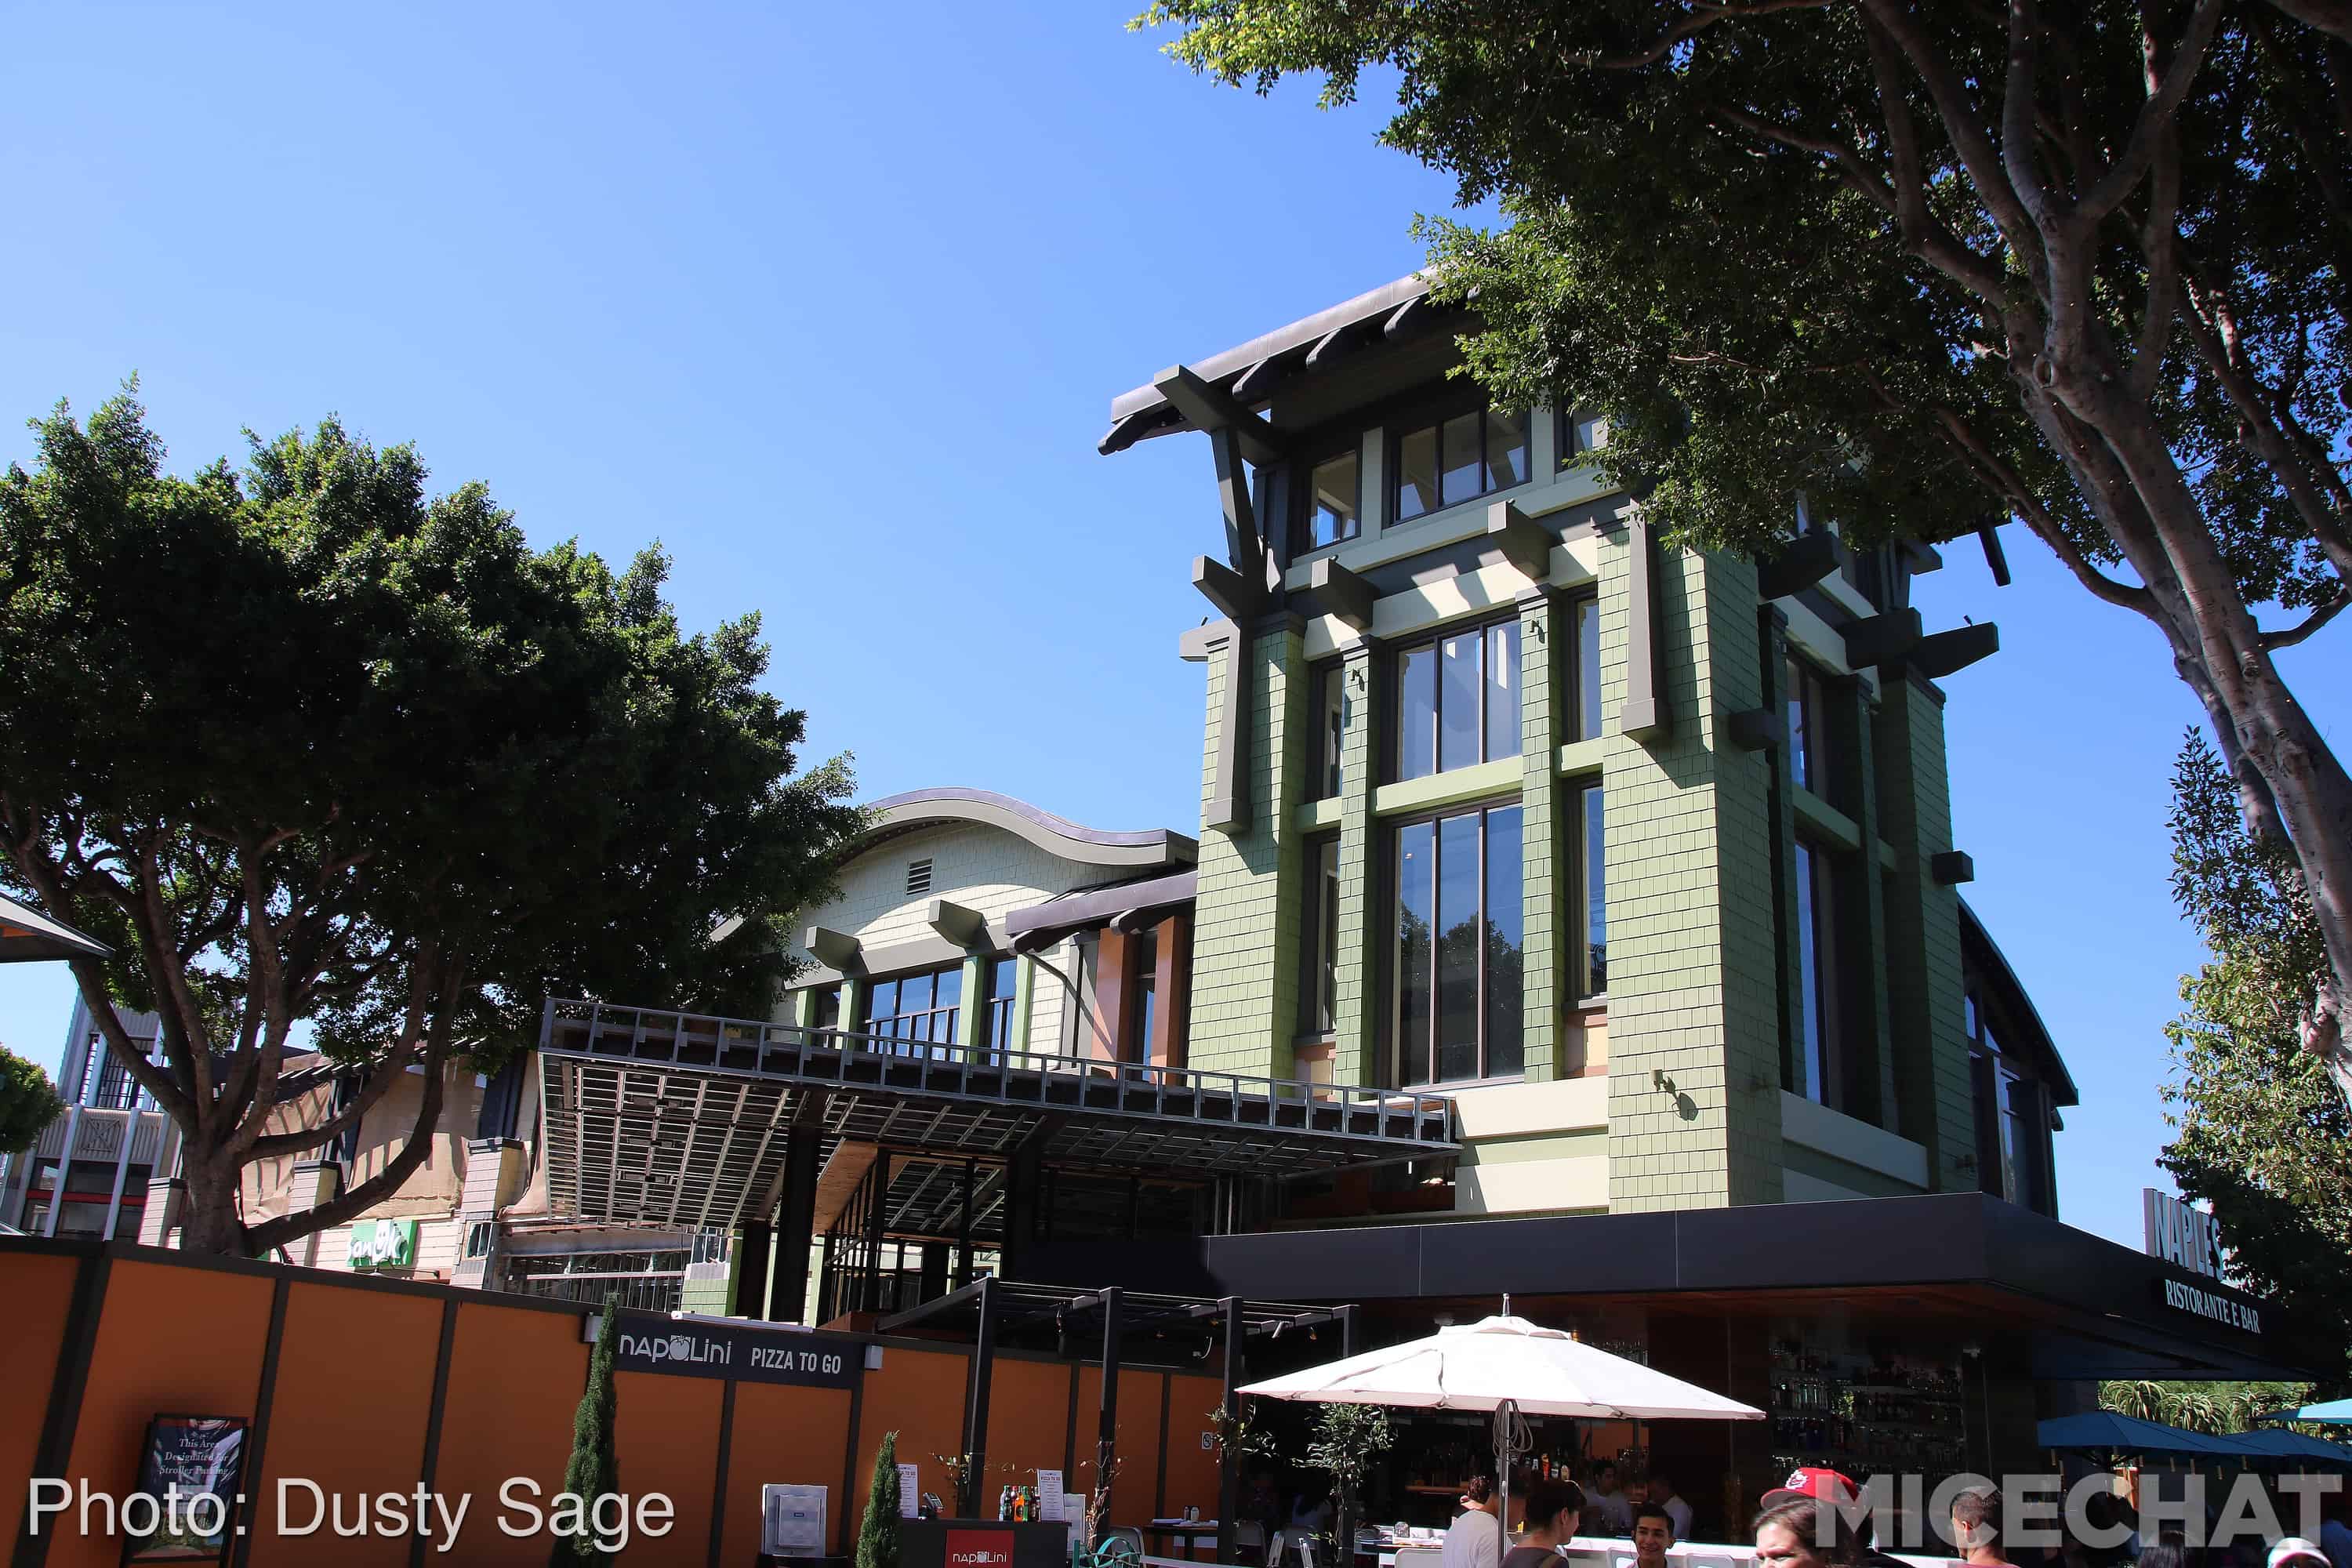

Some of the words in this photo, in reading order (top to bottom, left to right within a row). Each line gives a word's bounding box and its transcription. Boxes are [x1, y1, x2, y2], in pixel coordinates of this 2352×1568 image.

[2146, 1189, 2223, 1281] NAPLES
[2165, 1279, 2230, 1323] RISTORANTE
[2231, 1301, 2240, 1327] E
[2240, 1305, 2261, 1333] BAR
[750, 1347, 793, 1370] PIZZA
[799, 1352, 816, 1373] TO
[822, 1355, 841, 1374] GO
[179, 1439, 198, 1448] This
[200, 1439, 219, 1448] Are
[165, 1451, 215, 1463] Designated
[159, 1465, 194, 1475] Stroller
